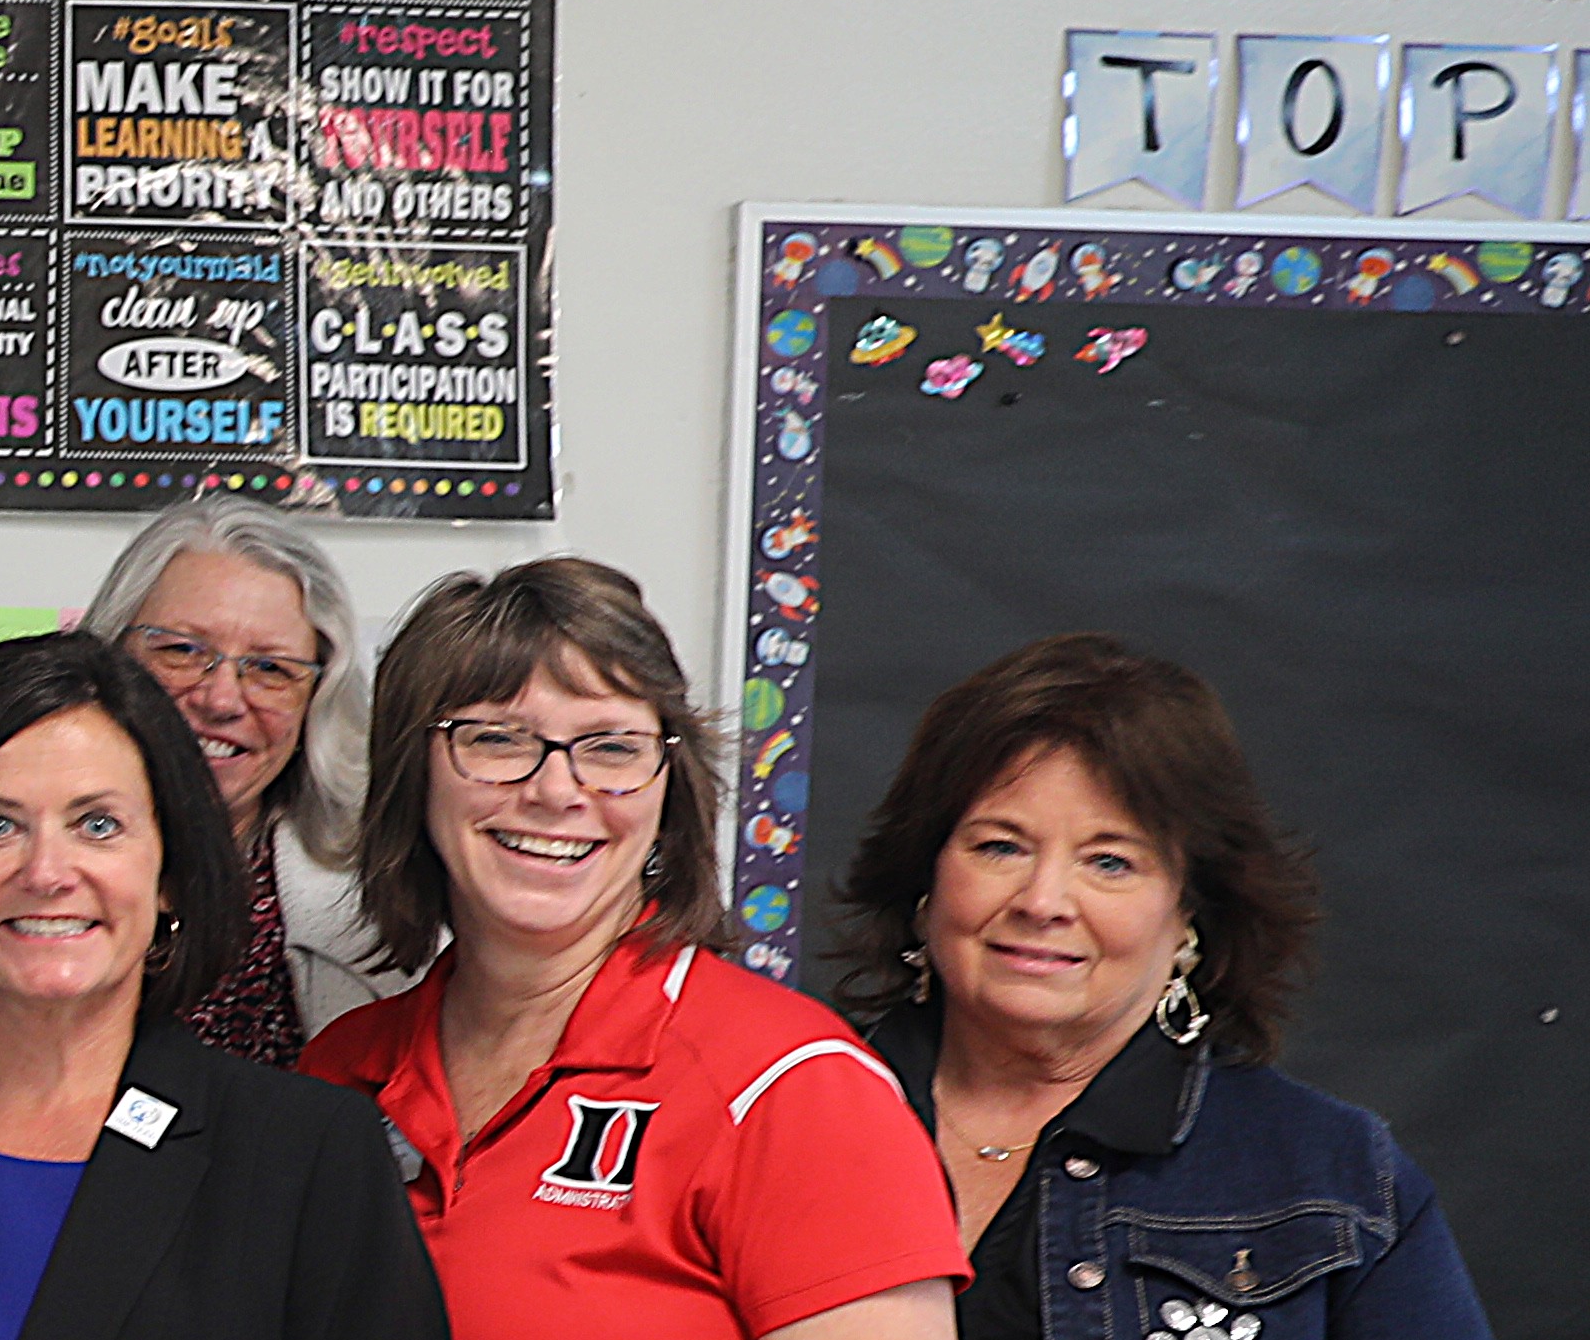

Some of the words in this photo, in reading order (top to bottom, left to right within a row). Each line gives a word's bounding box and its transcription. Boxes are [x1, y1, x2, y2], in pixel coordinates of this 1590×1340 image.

[112, 14, 235, 54] #goals
[339, 21, 499, 59] #respect
[76, 61, 238, 115] MAKE
[320, 64, 412, 104] SHOW
[418, 68, 448, 106] IT
[454, 70, 516, 108] FOR
[1100, 55, 1518, 162] TOP
[76, 117, 243, 161] LEARNING
[249, 121, 274, 161] A
[320, 106, 513, 173] YOURSELF
[76, 164, 276, 210] PRIORITY
[320, 178, 386, 223] AND
[393, 181, 513, 222] OTHERS
[73, 251, 282, 284] #notyourmaid
[102, 287, 197, 329] clean
[206, 300, 265, 344] up
[123, 351, 223, 379] AFTER
[311, 362, 517, 405] PARTICIPATION
[73, 398, 285, 445] YOURSELF
[325, 400, 356, 438] IS
[360, 402, 505, 445] REQUIRED
